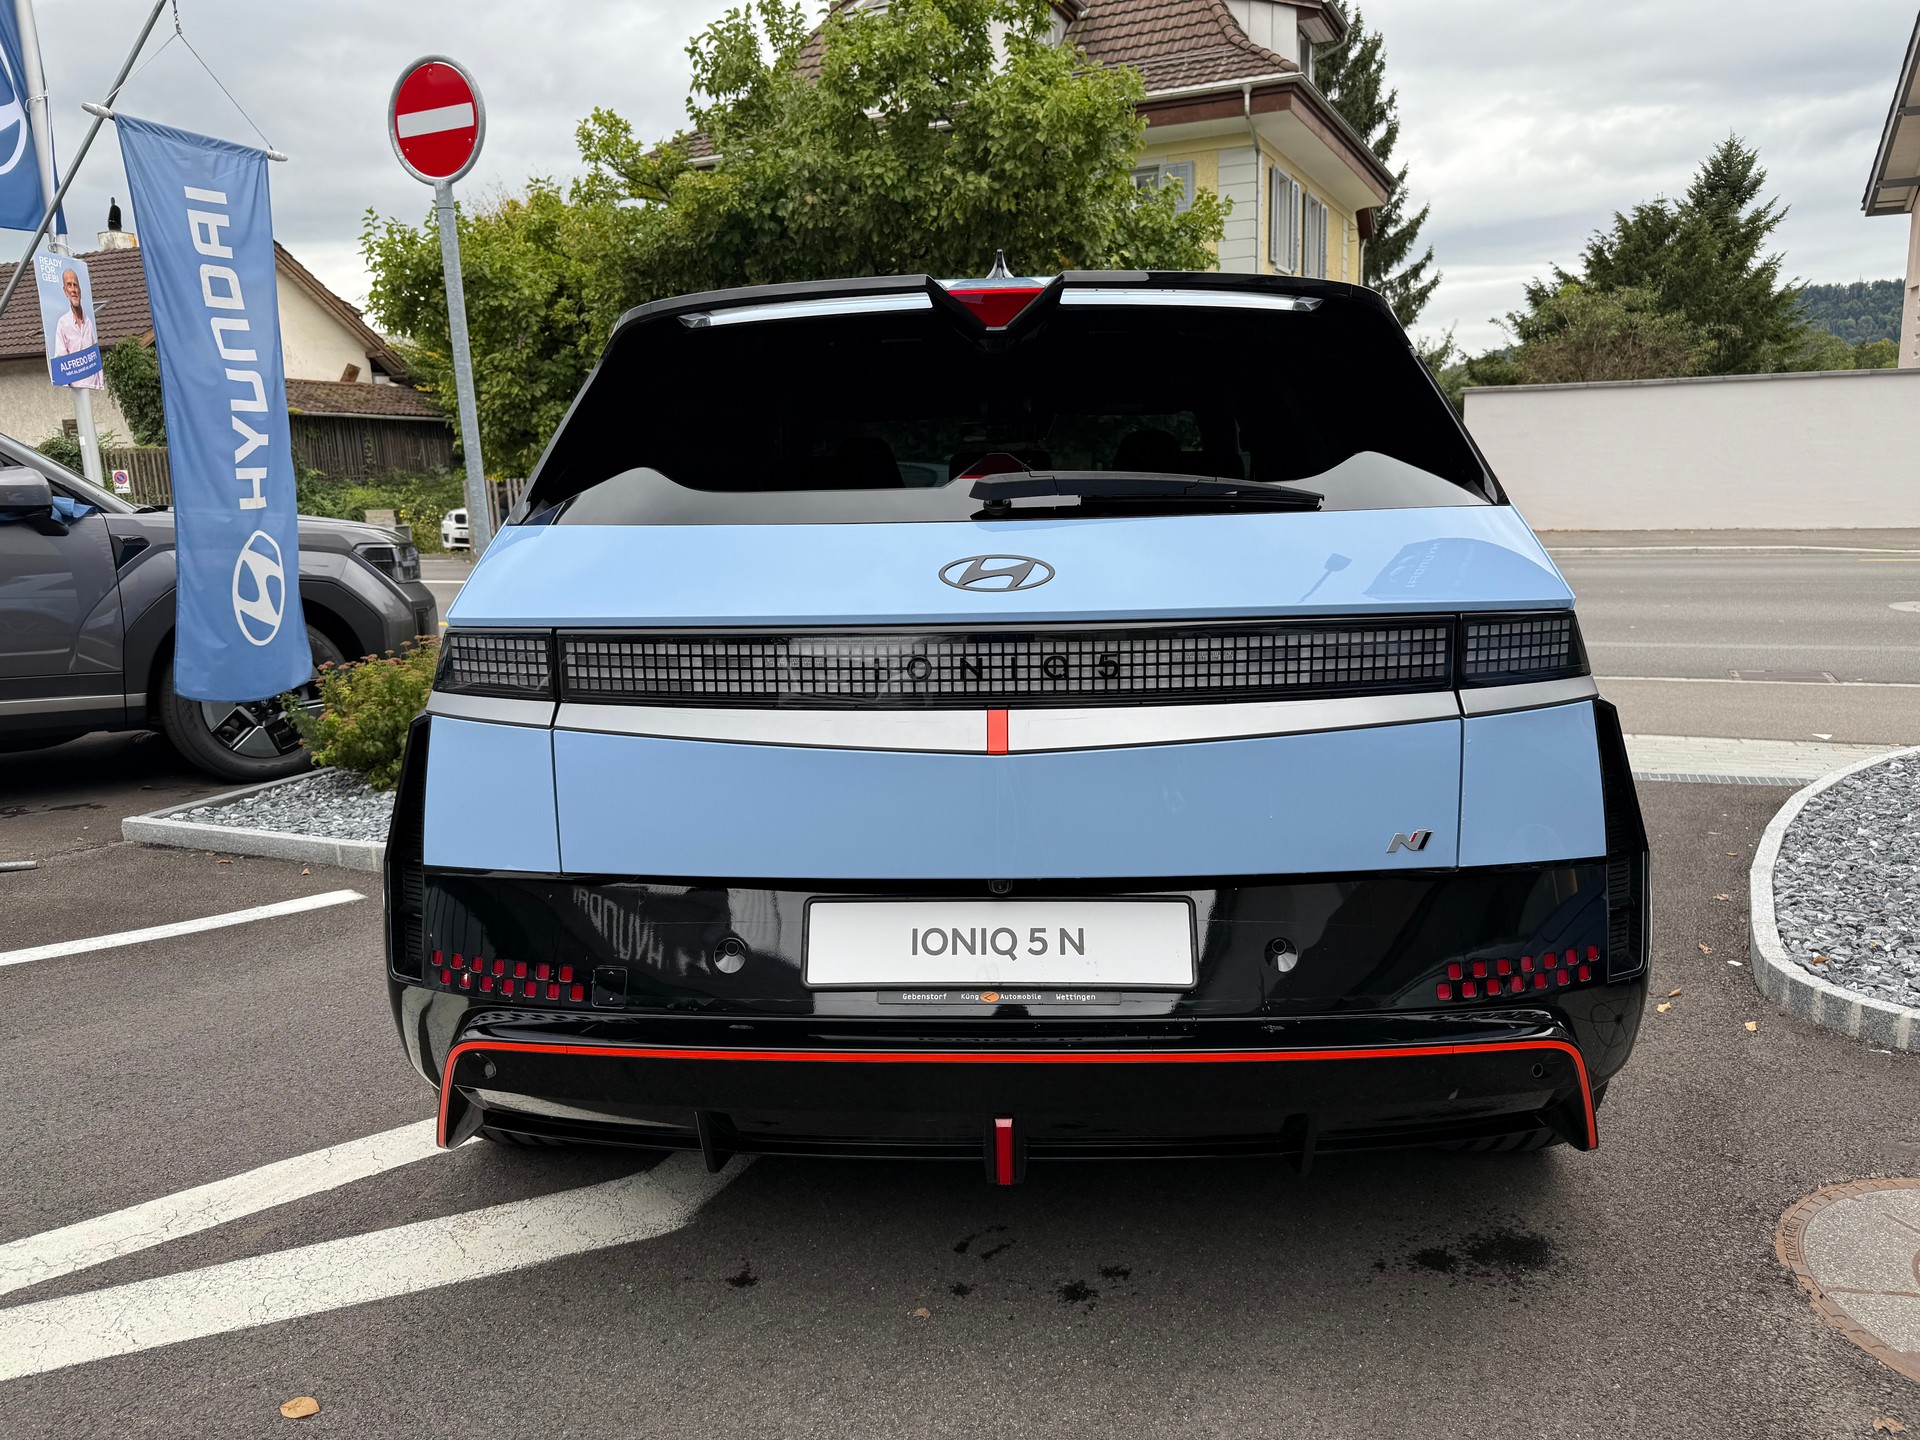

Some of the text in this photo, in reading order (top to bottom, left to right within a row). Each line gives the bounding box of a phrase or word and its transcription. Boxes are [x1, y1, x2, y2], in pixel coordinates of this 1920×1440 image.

[39, 256, 62, 268] READY
[41, 264, 56, 275] FOR
[42, 272, 60, 284] GEBI
[184, 186, 270, 510] HYUNDAI
[60, 355, 88, 372] ALFREDO
[874, 652, 1120, 682] IONIQ 5
[1385, 828, 1434, 854] N
[911, 926, 1085, 961] IONIQ 5 N
[902, 992, 1096, 1002] Gebenstorf Küng Automobile Wettingen
